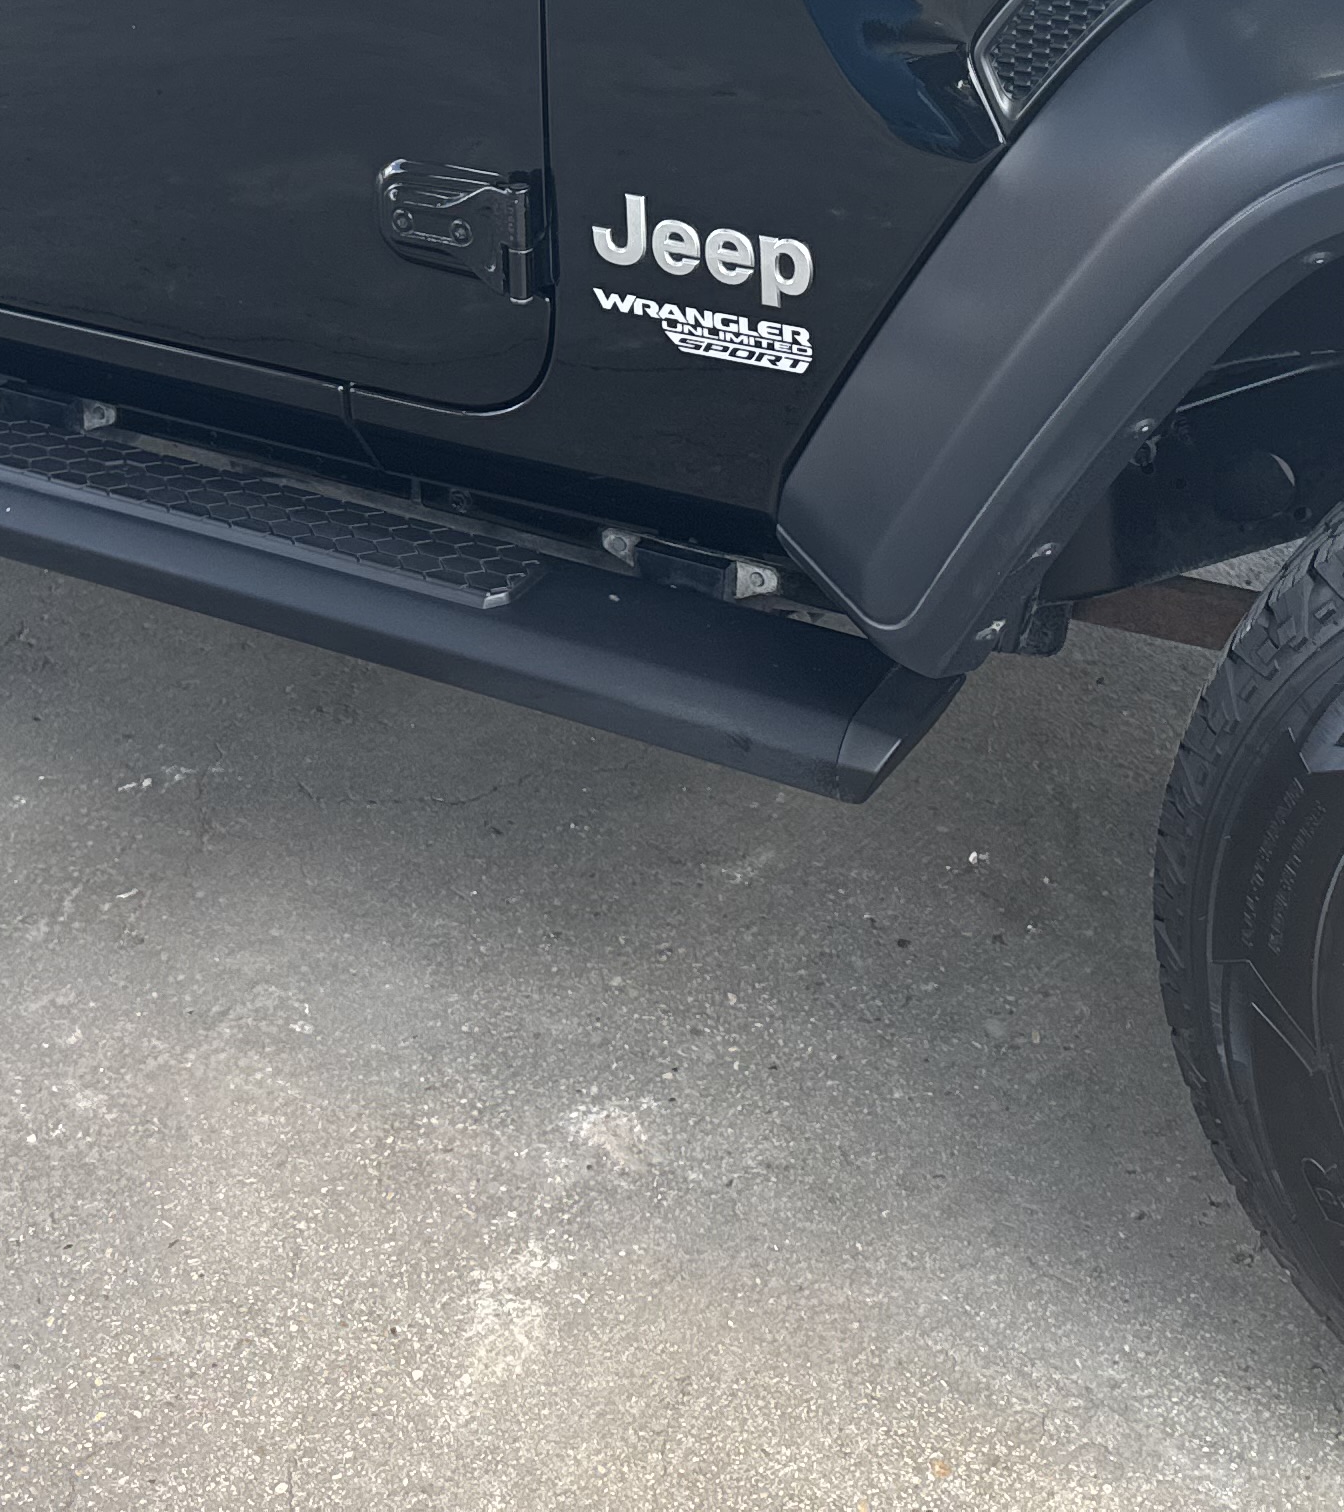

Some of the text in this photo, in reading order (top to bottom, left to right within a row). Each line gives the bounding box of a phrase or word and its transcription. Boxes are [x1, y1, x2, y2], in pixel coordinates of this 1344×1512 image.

[592, 192, 814, 309] Jeep
[592, 287, 812, 347] WRANGLER
[661, 320, 813, 357] UNLIMITED
[674, 335, 810, 371] SPORT
